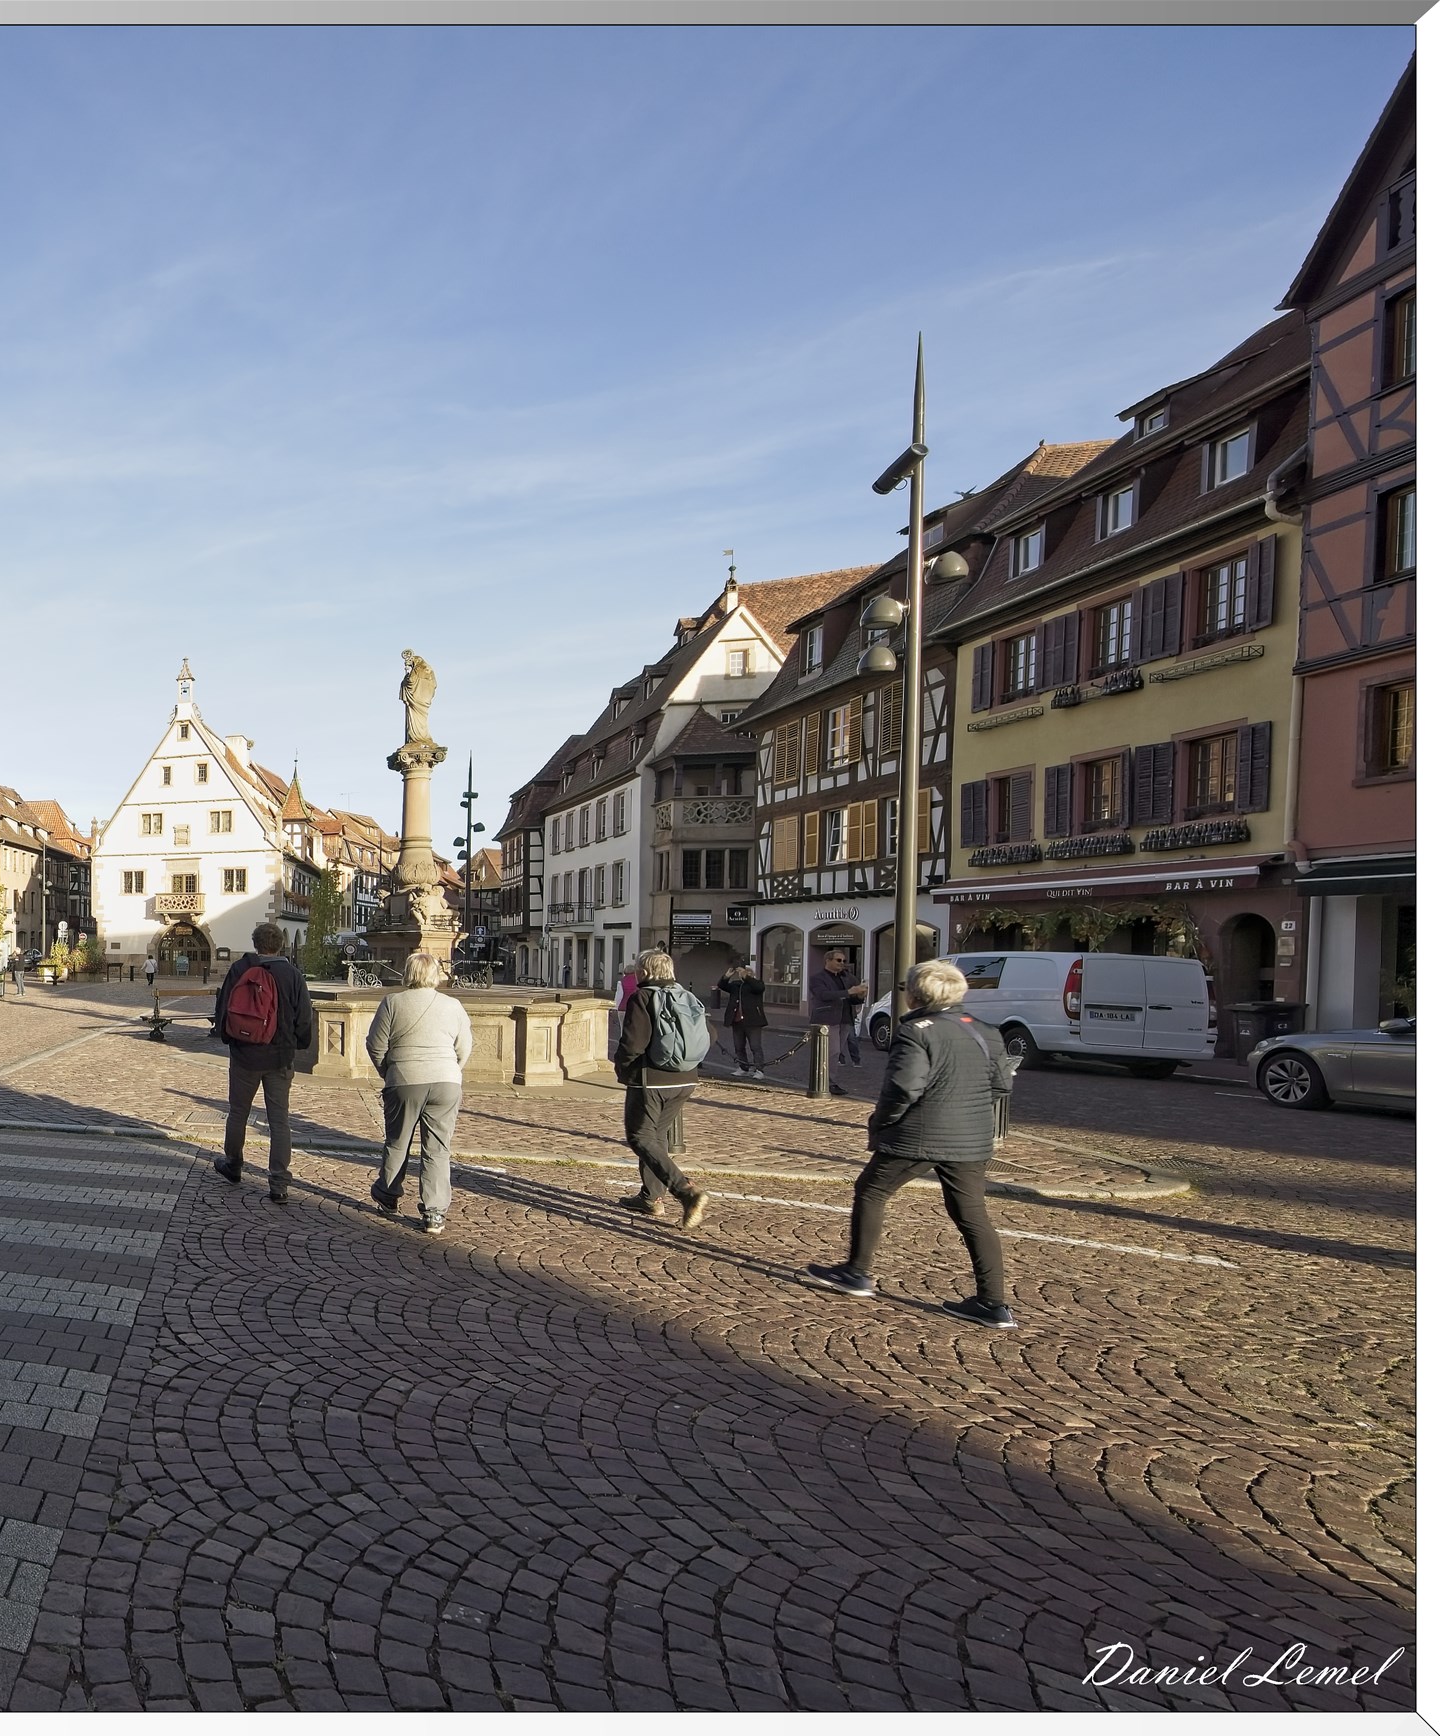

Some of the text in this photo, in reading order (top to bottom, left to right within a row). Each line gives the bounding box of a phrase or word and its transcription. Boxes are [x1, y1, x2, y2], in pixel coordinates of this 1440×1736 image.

[1165, 878, 1234, 891] BAR À VIN
[949, 893, 965, 902] BAR
[975, 893, 991, 901] VIN
[1046, 889, 1060, 899] QUI
[1061, 889, 1076, 897] DIT
